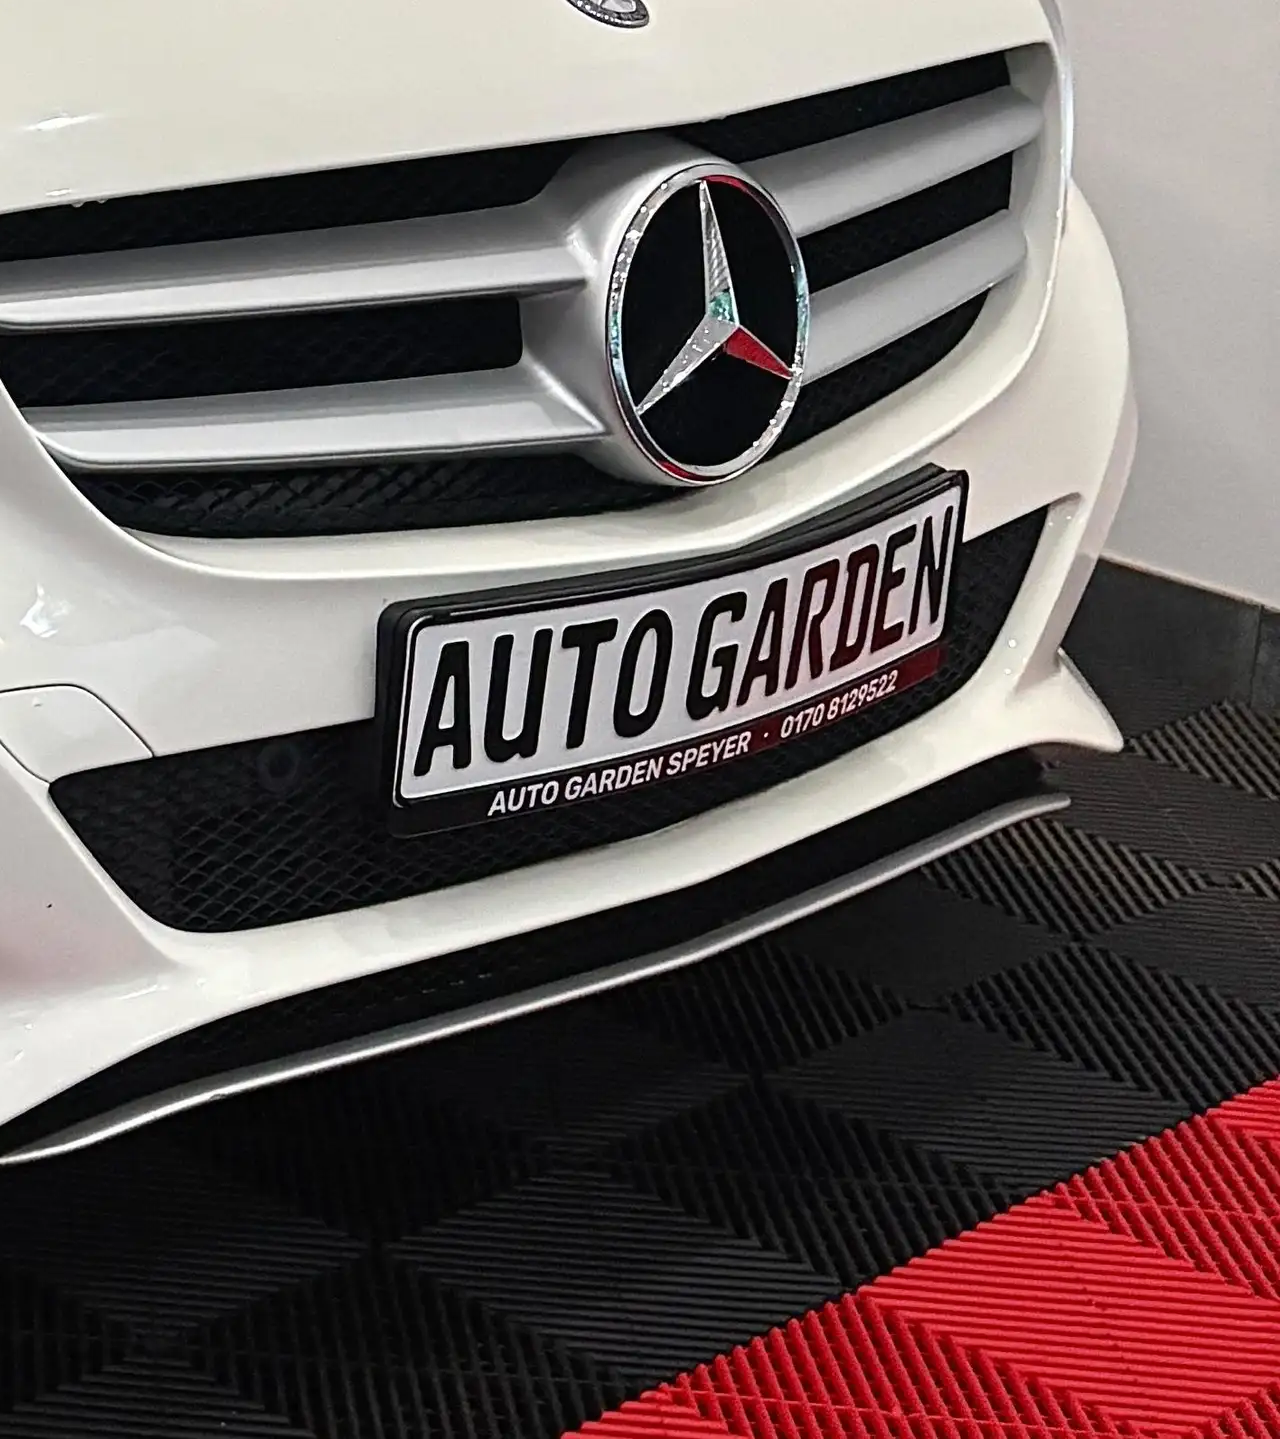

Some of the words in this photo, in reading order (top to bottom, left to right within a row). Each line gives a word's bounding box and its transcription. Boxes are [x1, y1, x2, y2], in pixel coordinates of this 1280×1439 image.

[413, 608, 673, 777] AUTO
[685, 504, 955, 721] GARDEN
[487, 780, 559, 817] AUTO
[564, 756, 664, 800] GARDEN
[665, 731, 752, 776] SPEYER
[780, 702, 825, 739] 0170
[826, 669, 899, 720] 8129522
